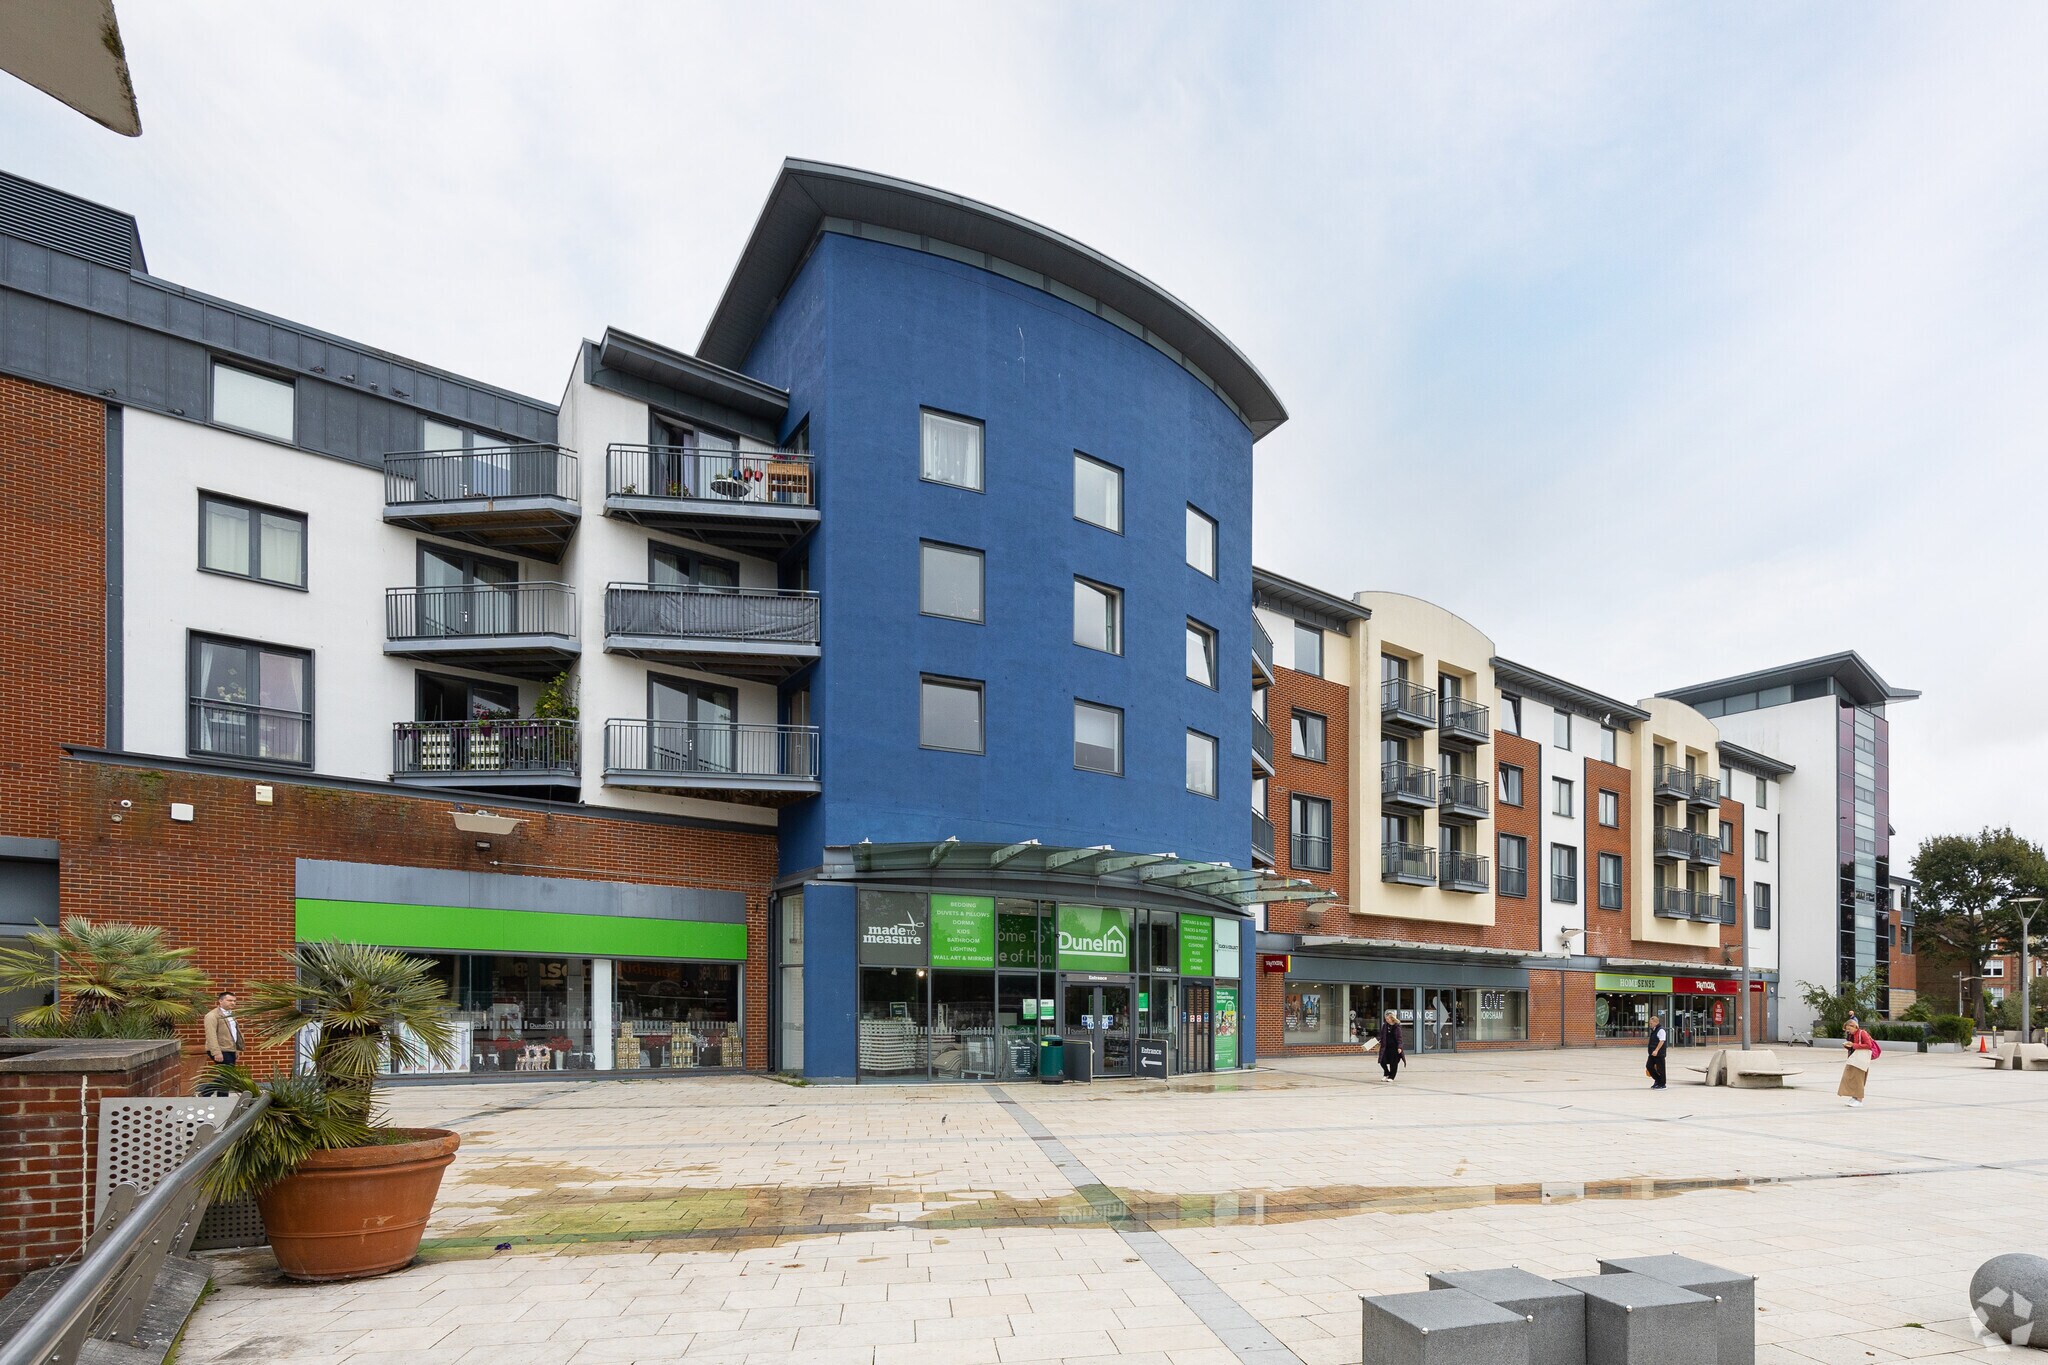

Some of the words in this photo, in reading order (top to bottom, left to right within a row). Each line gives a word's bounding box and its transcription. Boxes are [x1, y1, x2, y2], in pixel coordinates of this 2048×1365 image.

[868, 925, 906, 935] made
[862, 934, 922, 945] measure
[998, 931, 1027, 943] ome
[1059, 930, 1123, 953] Dunelm
[1010, 949, 1024, 963] of
[1480, 993, 1505, 1010] LOVE
[1141, 1047, 1162, 1055] Entrance
